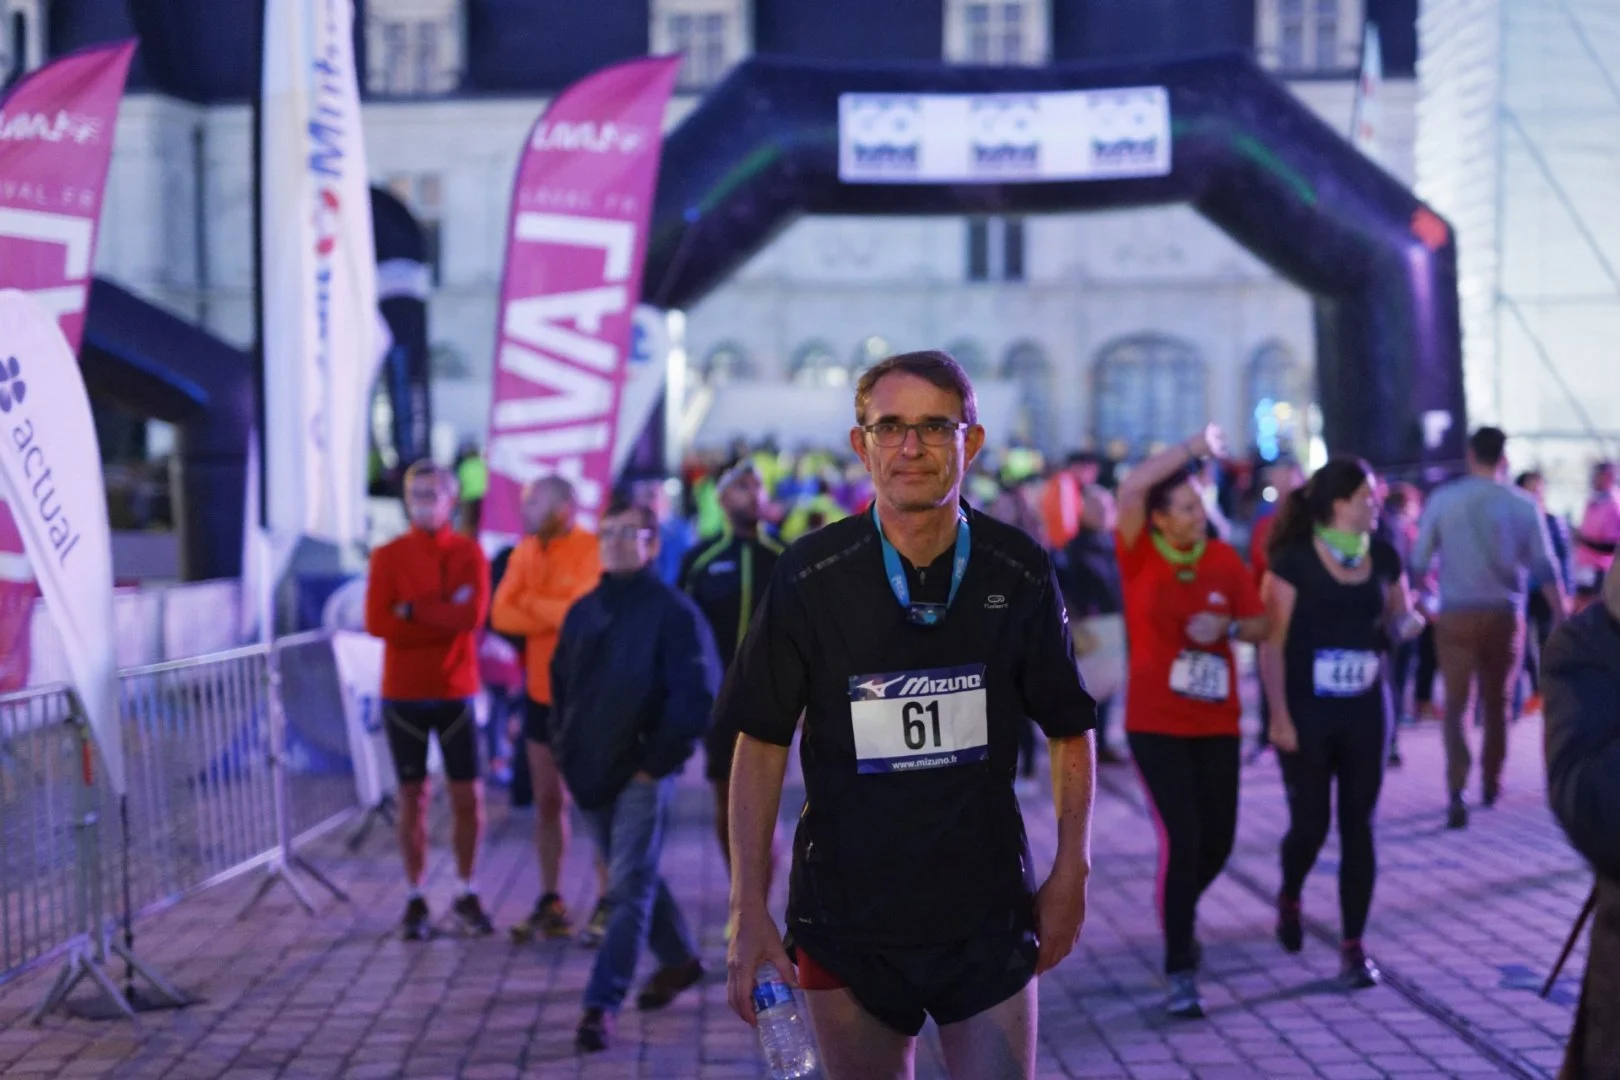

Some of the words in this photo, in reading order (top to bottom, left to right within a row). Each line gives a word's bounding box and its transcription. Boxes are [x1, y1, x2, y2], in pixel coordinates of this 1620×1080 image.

[12, 417, 80, 568] actual
[902, 700, 942, 750] 61
[892, 755, 958, 770] www.mizuno.fr
